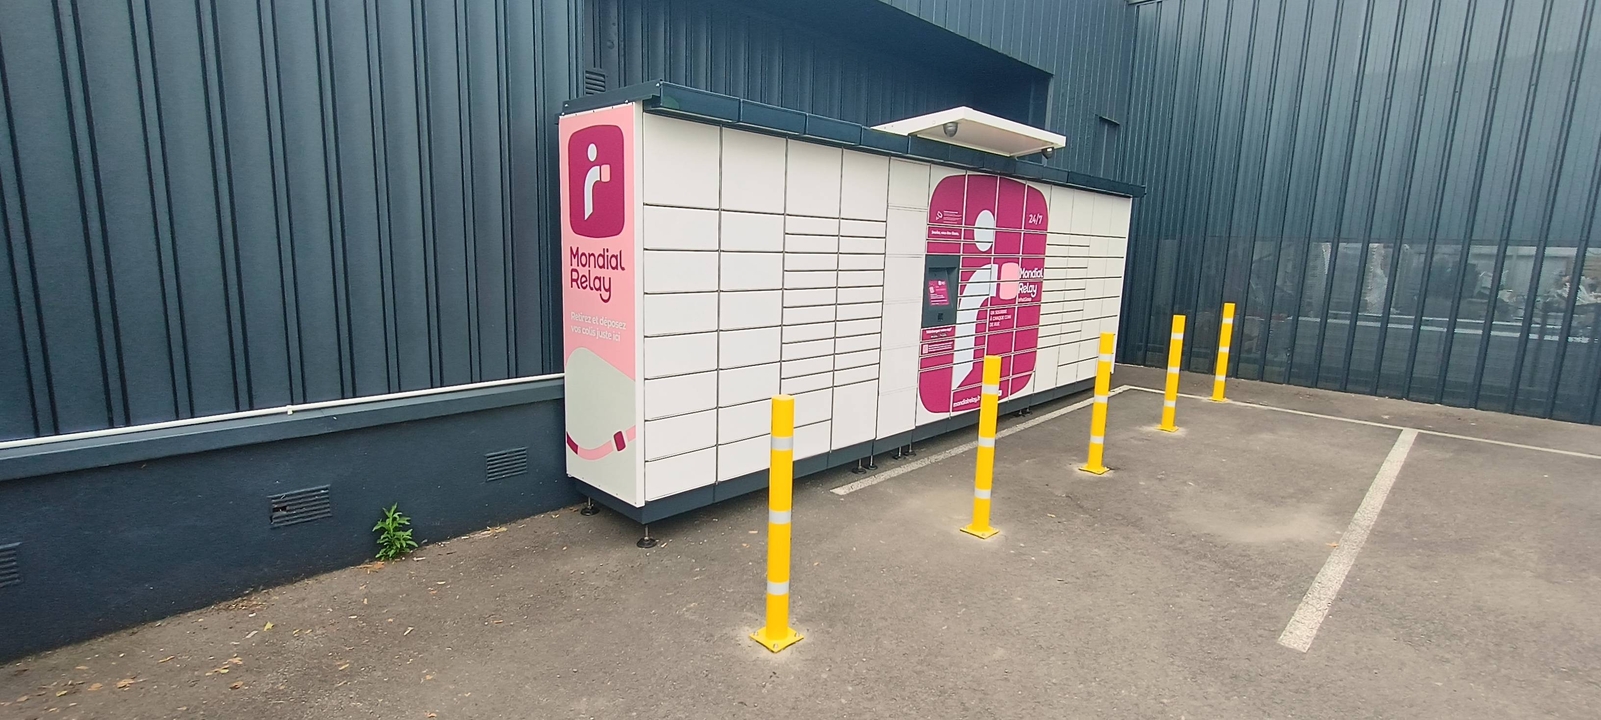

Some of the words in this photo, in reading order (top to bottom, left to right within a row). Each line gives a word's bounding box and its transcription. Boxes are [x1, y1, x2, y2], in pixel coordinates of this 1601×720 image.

[1028, 213, 1043, 225] 24/7
[569, 246, 625, 271] Mondial
[1019, 267, 1044, 278] Mondial
[570, 268, 612, 303] Relay
[1018, 282, 1038, 298] Relay
[570, 311, 591, 324] Retirez
[592, 315, 598, 325] et
[600, 315, 626, 330] déposez
[570, 325, 581, 333] vos
[582, 326, 596, 337] colis
[596, 328, 612, 340] juste
[613, 331, 621, 341] ici
